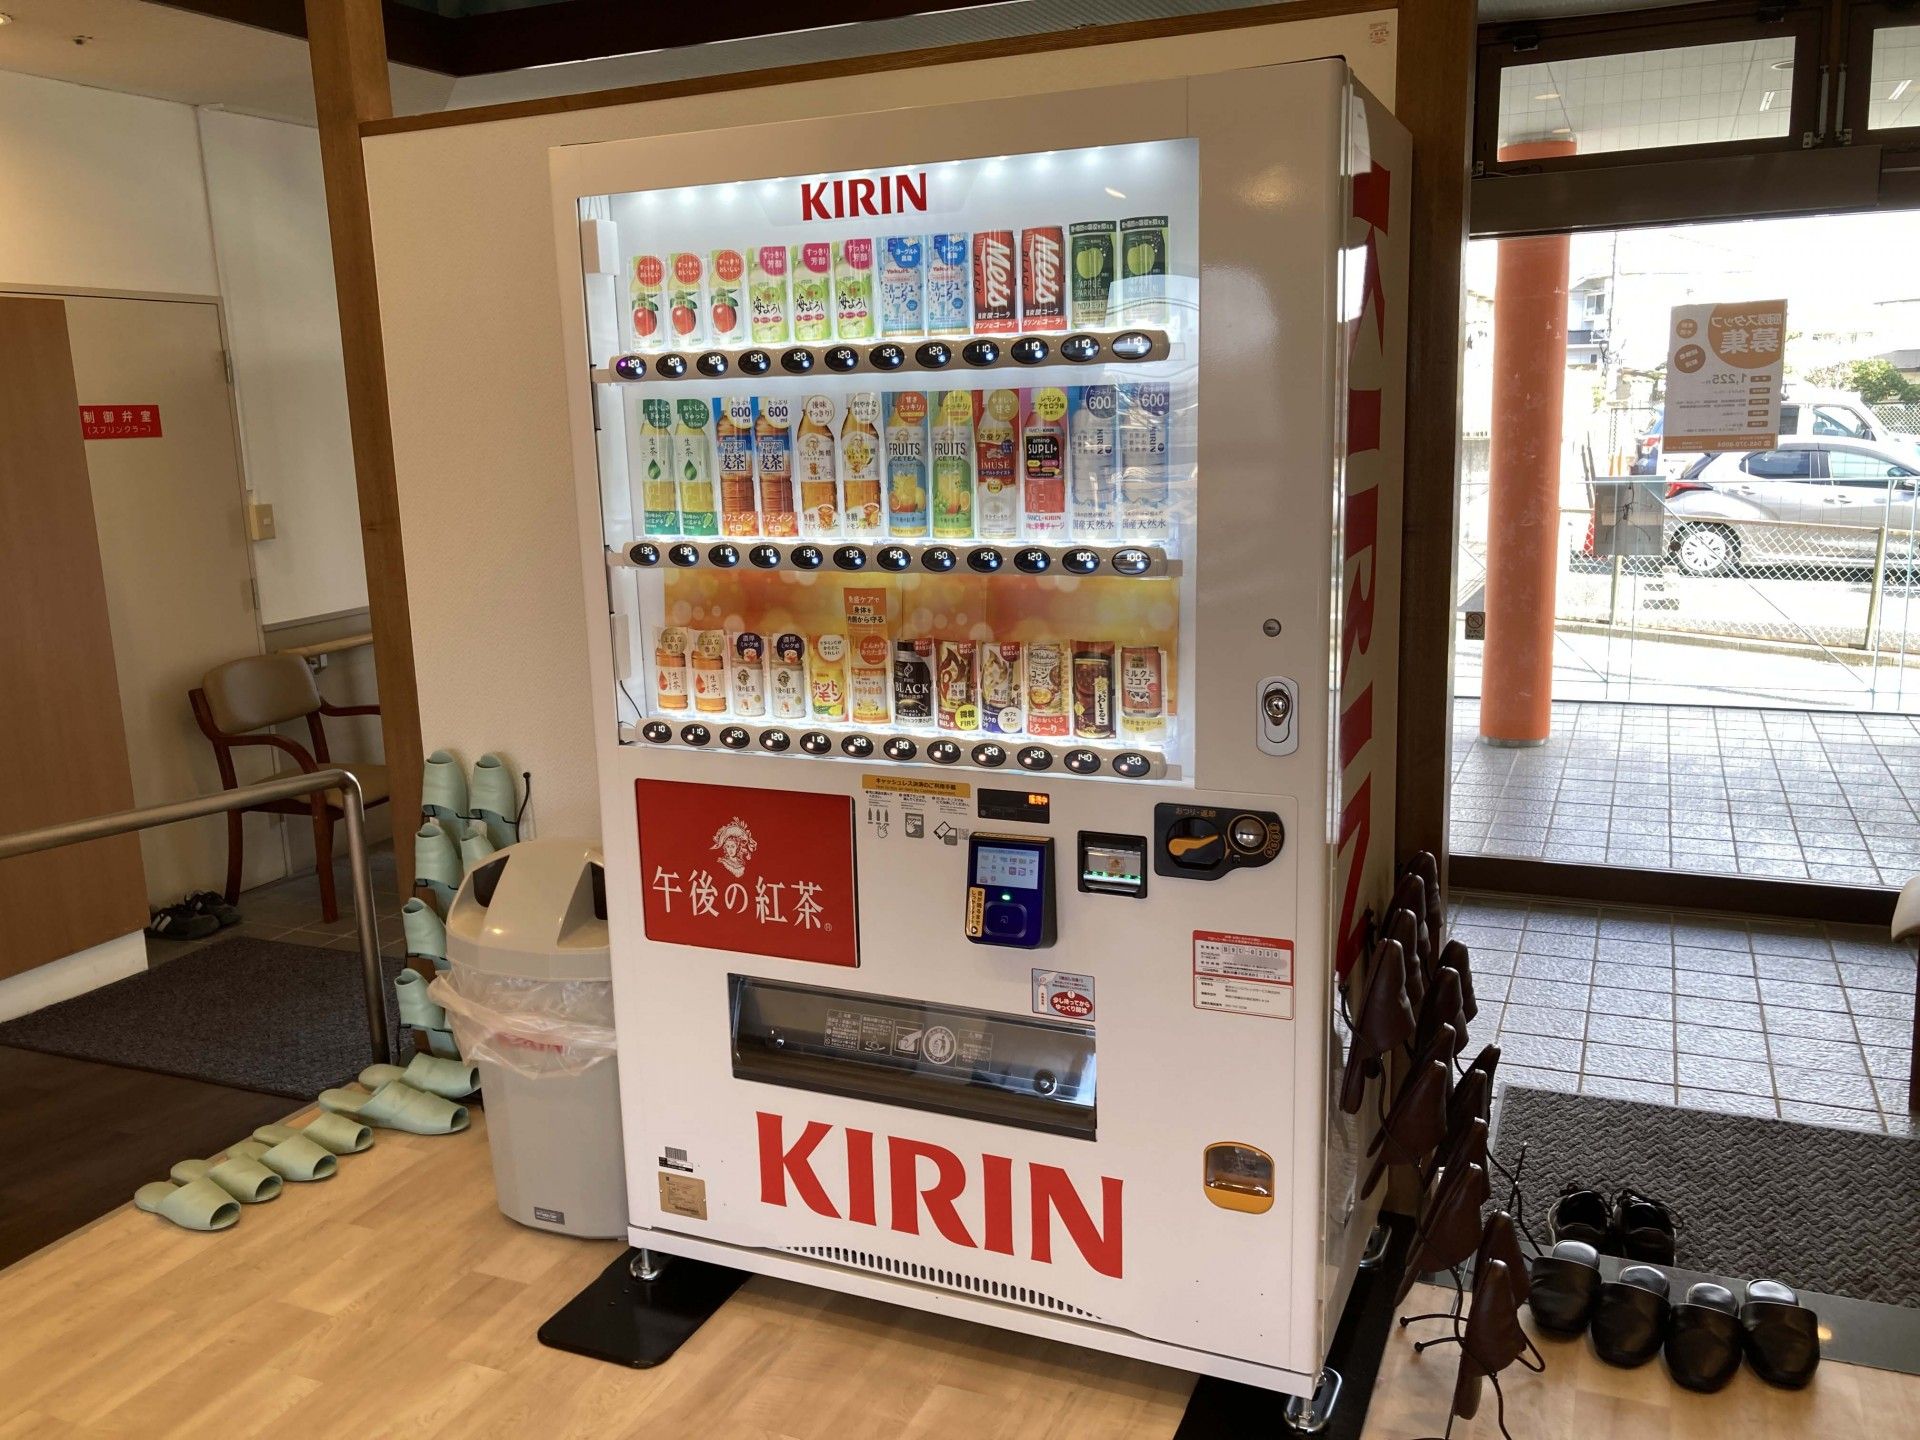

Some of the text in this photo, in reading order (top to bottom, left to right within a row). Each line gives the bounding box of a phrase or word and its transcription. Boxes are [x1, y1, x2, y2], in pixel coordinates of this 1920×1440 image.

[801, 172, 928, 222] KIRIN
[986, 237, 1010, 308] Mets
[1034, 233, 1060, 304] Mets
[1075, 339, 1090, 349] 110
[1127, 336, 1142, 345] 110
[929, 346, 942, 355] 120
[976, 344, 990, 353] 110
[1025, 341, 1039, 351] 110
[793, 351, 807, 361] 120
[838, 350, 851, 359] 120
[882, 348, 896, 357] 120
[627, 359, 640, 368] 120
[667, 357, 680, 366] 120
[708, 355, 721, 365] 120
[750, 354, 763, 363] 120
[1088, 396, 1111, 409] 600
[1142, 393, 1165, 407] 600
[731, 407, 751, 417] 600
[768, 406, 789, 417] 600
[83, 411, 152, 423] 制御弁室
[888, 442, 920, 456] FRUITS
[934, 442, 966, 456] FRUITS
[723, 454, 744, 470] 麦茶
[762, 454, 782, 470] 麦茶
[729, 524, 743, 532] ゼロ
[768, 525, 782, 533] ゼロ
[640, 546, 653, 555] 130
[680, 546, 693, 555] 130
[720, 548, 732, 556] 110
[761, 548, 774, 557] 110
[803, 549, 816, 558] 130
[846, 549, 860, 558] 130
[889, 550, 903, 559] 150
[934, 551, 948, 560] 150
[980, 551, 995, 560] 150
[1027, 551, 1042, 561] 120
[1076, 552, 1091, 562] 100
[1127, 552, 1142, 562] 100
[1336, 166, 1391, 976] KIRIN
[1031, 671, 1049, 679] コーン
[1125, 669, 1154, 678] ミルクと
[812, 681, 838, 692] ホット
[1128, 678, 1151, 686] ココア
[895, 682, 930, 694] BLACK
[653, 724, 666, 733] 110
[691, 727, 704, 736] 110
[730, 730, 744, 739] 120
[771, 732, 784, 741] 120
[811, 735, 825, 744] 110
[853, 737, 867, 747] 120
[895, 740, 909, 750] 130
[939, 743, 953, 753] 110
[984, 746, 998, 756] 120
[1030, 749, 1045, 759] 120
[1078, 753, 1092, 762] 140
[1126, 756, 1142, 766] 120
[653, 865, 824, 929] 午後の紅茶
[756, 1111, 1124, 1280] KIRIN
